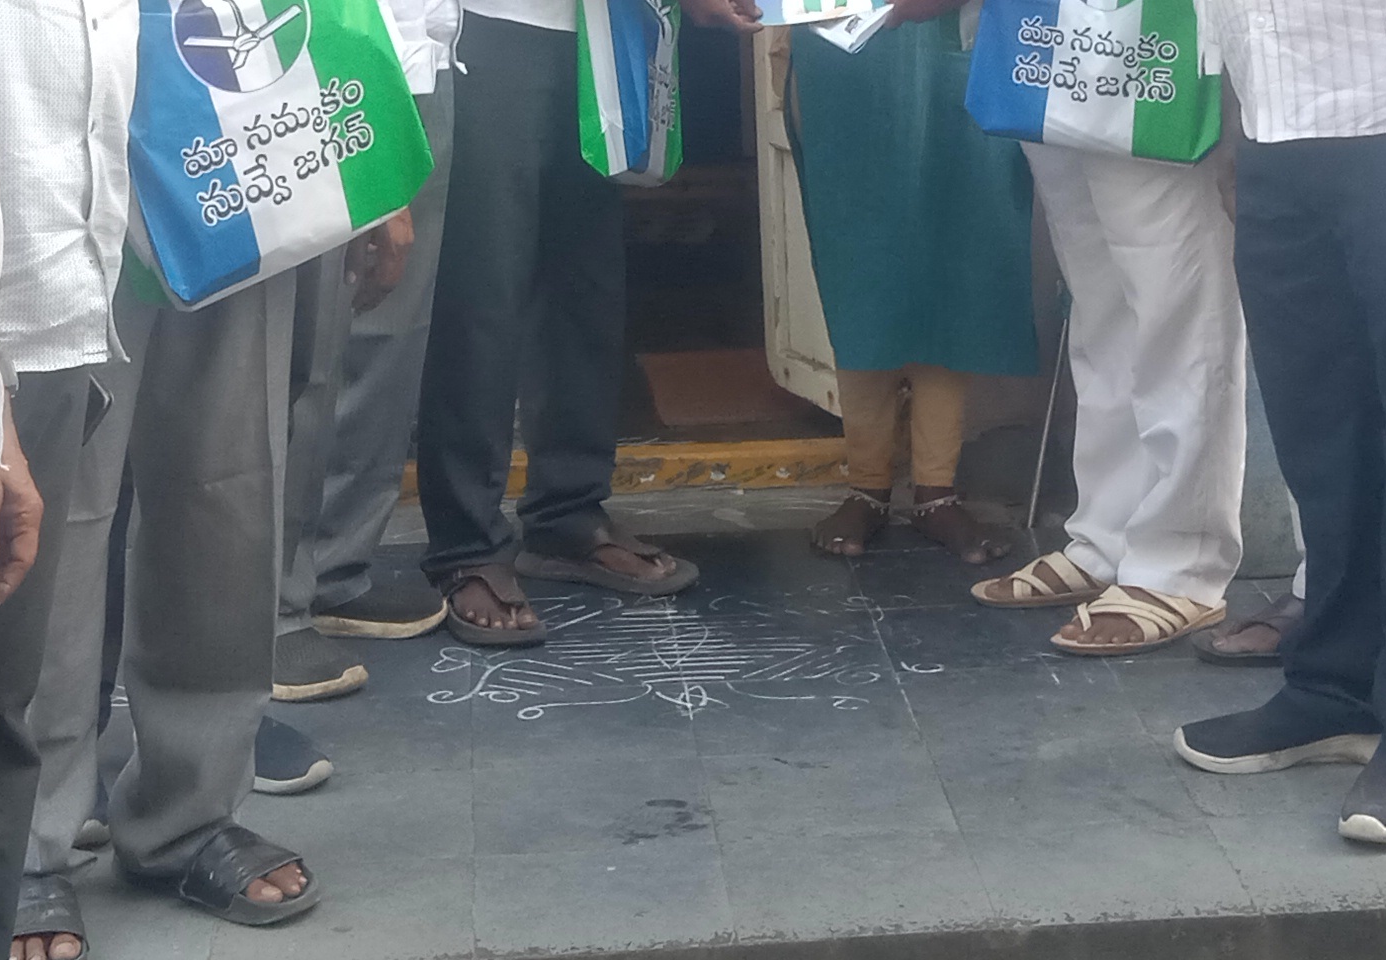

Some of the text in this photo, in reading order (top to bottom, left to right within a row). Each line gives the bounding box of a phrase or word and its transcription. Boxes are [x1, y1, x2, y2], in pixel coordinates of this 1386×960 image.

[1012, 53, 1177, 104] నువ్వే జగన్
[1018, 15, 1179, 69] మా నమ్మకం
[181, 77, 365, 179] మా నమ్మకం
[196, 113, 374, 227] నువ్వే జగన్
